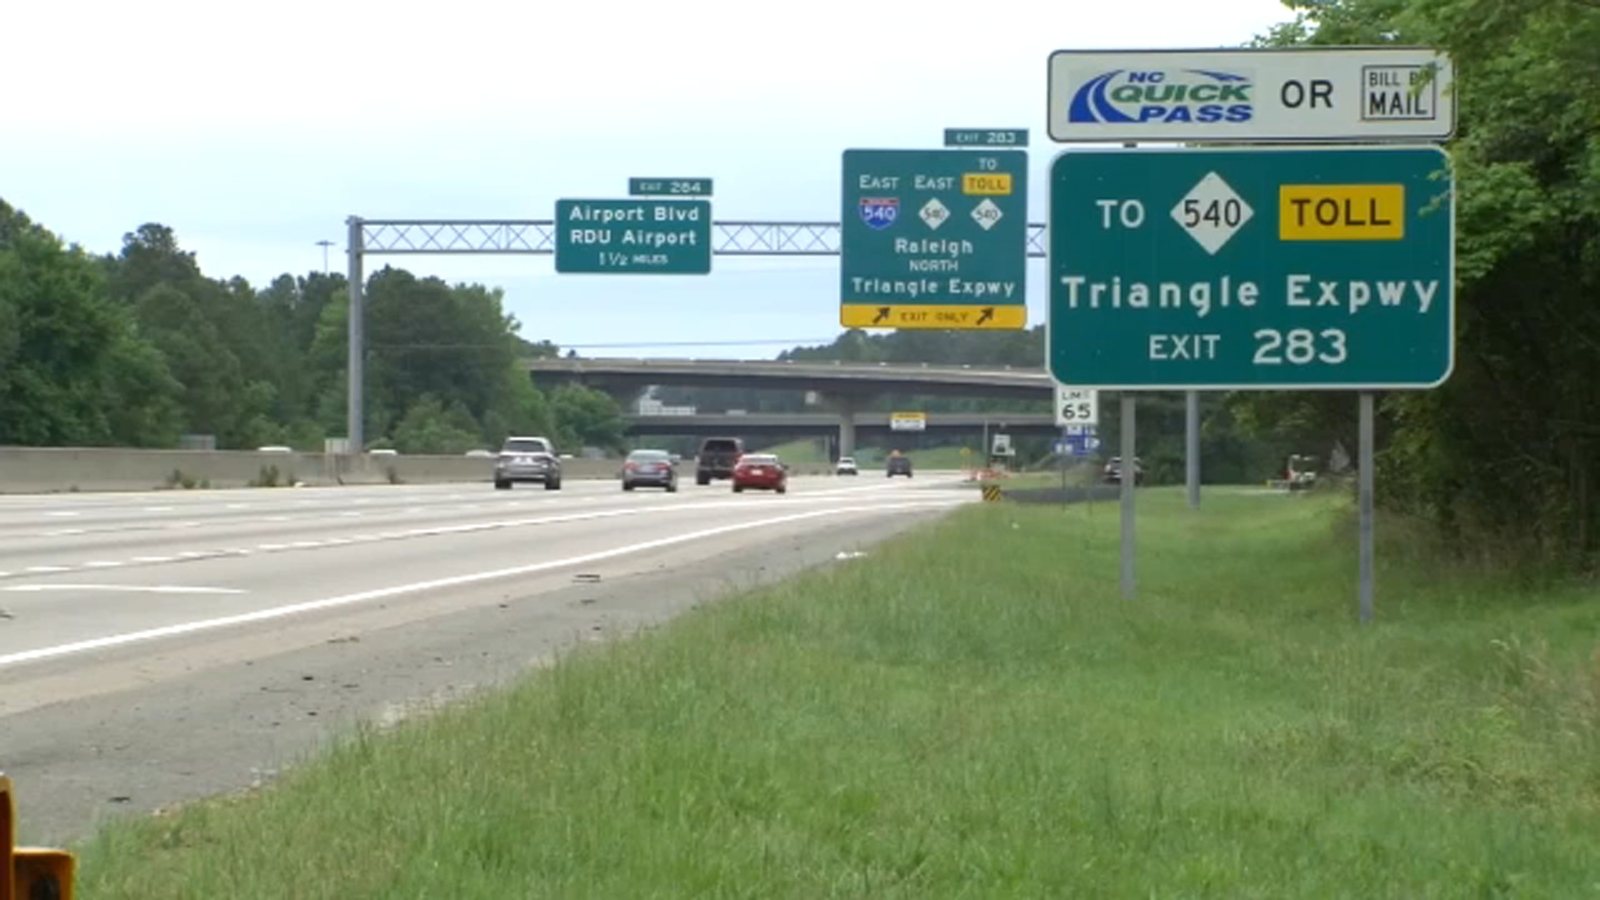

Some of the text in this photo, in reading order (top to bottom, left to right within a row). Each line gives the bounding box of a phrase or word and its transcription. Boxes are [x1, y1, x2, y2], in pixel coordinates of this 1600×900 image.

[1128, 72, 1165, 83] NC
[1369, 72, 1400, 87] BILL
[1111, 84, 1253, 103] QUICK
[1280, 79, 1334, 108] OR
[1369, 91, 1428, 115] MAIL
[1139, 105, 1253, 123] PASS
[956, 132, 1016, 143] EXIT 283
[978, 158, 998, 171] TO
[669, 181, 702, 193] 284
[859, 175, 899, 190] EAST
[914, 175, 954, 190] EAST
[968, 177, 1006, 190] TOLL
[569, 206, 699, 223] Airport Blvd
[863, 206, 897, 221] 540
[976, 208, 998, 220] 540
[1096, 199, 1145, 229] TO
[1183, 199, 1242, 228] 540
[1291, 198, 1392, 227] TOLL
[570, 229, 697, 248] RDU Airport
[894, 238, 974, 258] Raleigh
[632, 254, 669, 265] MILES
[909, 260, 959, 272] NORTH
[852, 277, 1016, 298] Triangle Expwy
[1061, 274, 1439, 317] Triangle Expwy
[901, 311, 969, 322] EXIT ONLY
[1148, 328, 1347, 365] EXIT 283
[1062, 402, 1091, 420] 65
